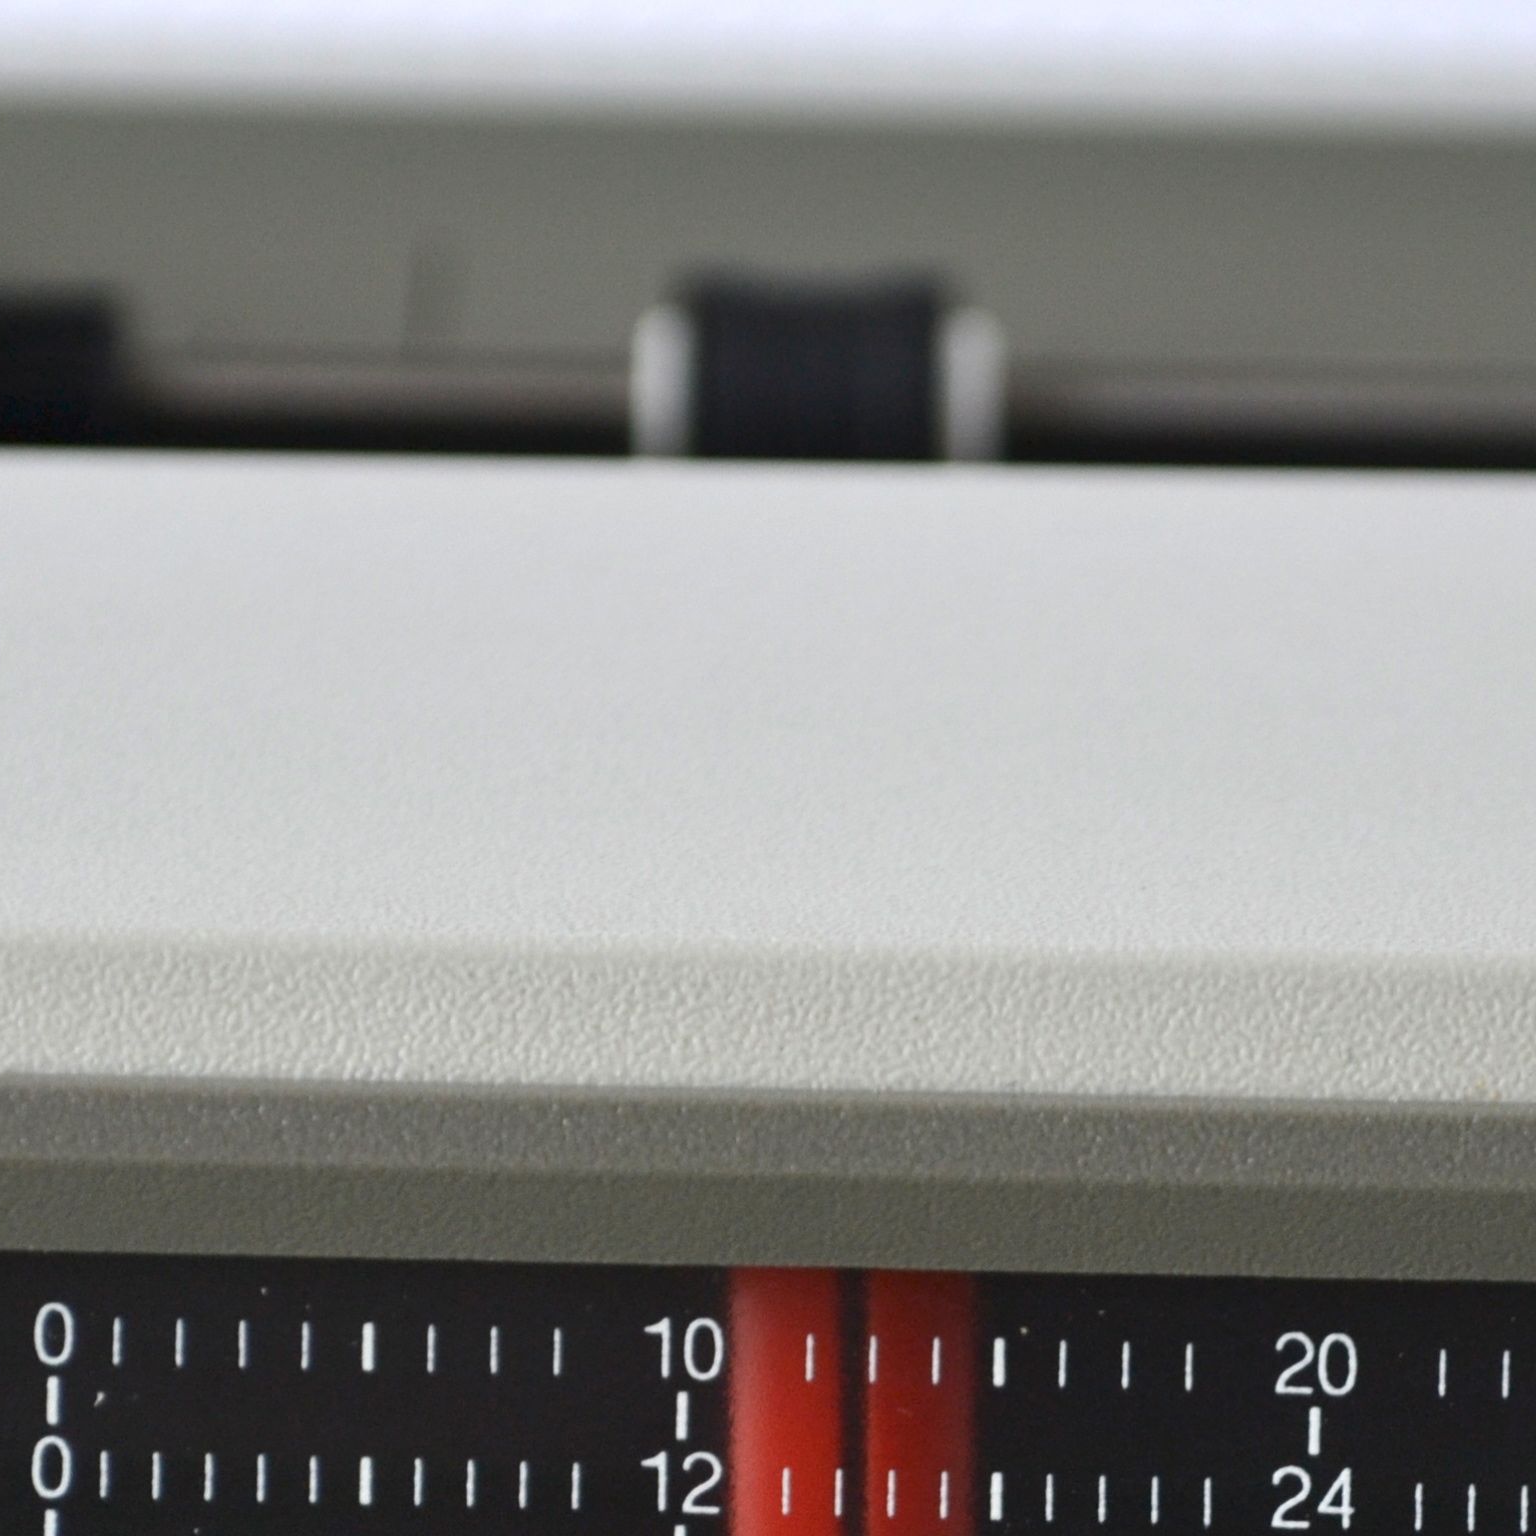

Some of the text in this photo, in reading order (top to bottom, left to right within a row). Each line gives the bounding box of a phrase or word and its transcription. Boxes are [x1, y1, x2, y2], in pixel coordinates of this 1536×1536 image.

[34, 1303, 74, 1366] 0
[644, 1317, 724, 1382] 10
[1274, 1331, 1358, 1396] 20
[31, 1435, 72, 1500] 0
[640, 1450, 723, 1515] 12
[1270, 1464, 1355, 1530] 24
